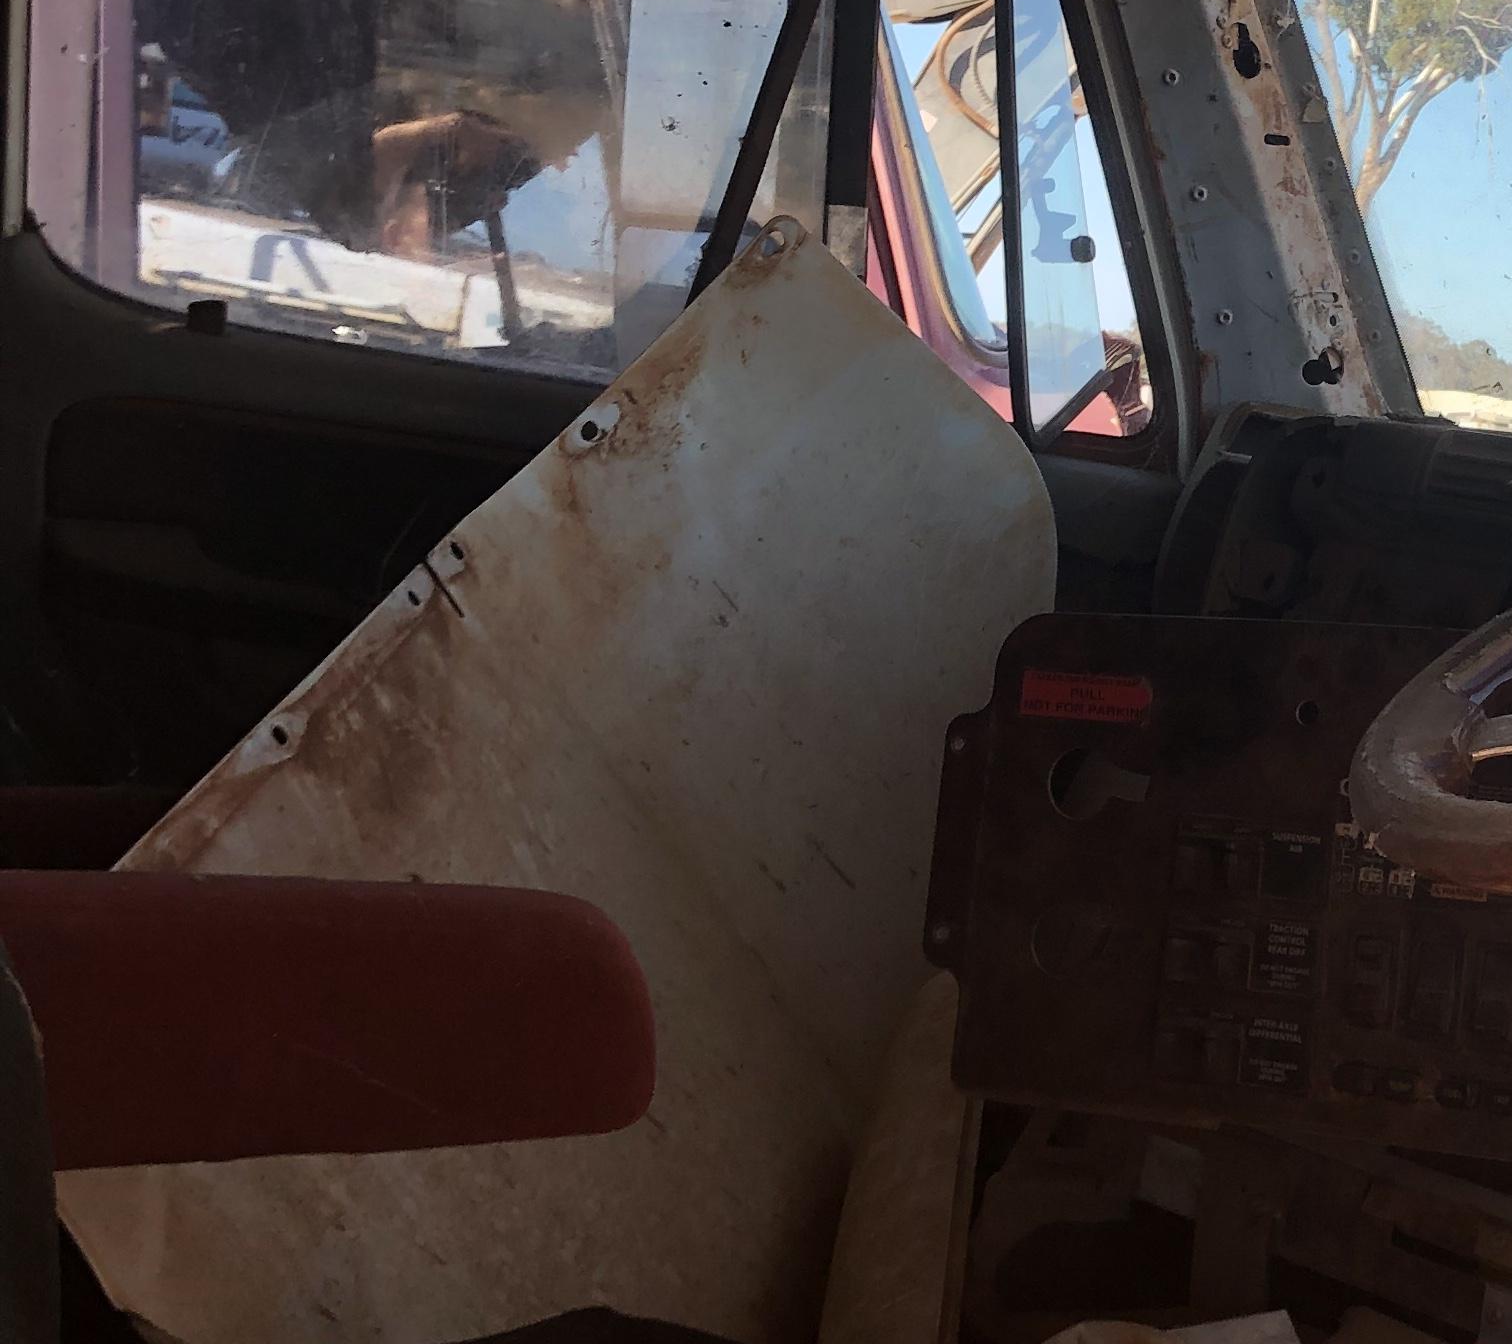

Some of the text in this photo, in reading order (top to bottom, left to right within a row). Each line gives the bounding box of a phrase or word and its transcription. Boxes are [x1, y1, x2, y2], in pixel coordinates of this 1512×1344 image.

[1070, 687, 1105, 701] PULL
[1024, 699, 1051, 711] NOT
[1055, 702, 1084, 714] FOR
